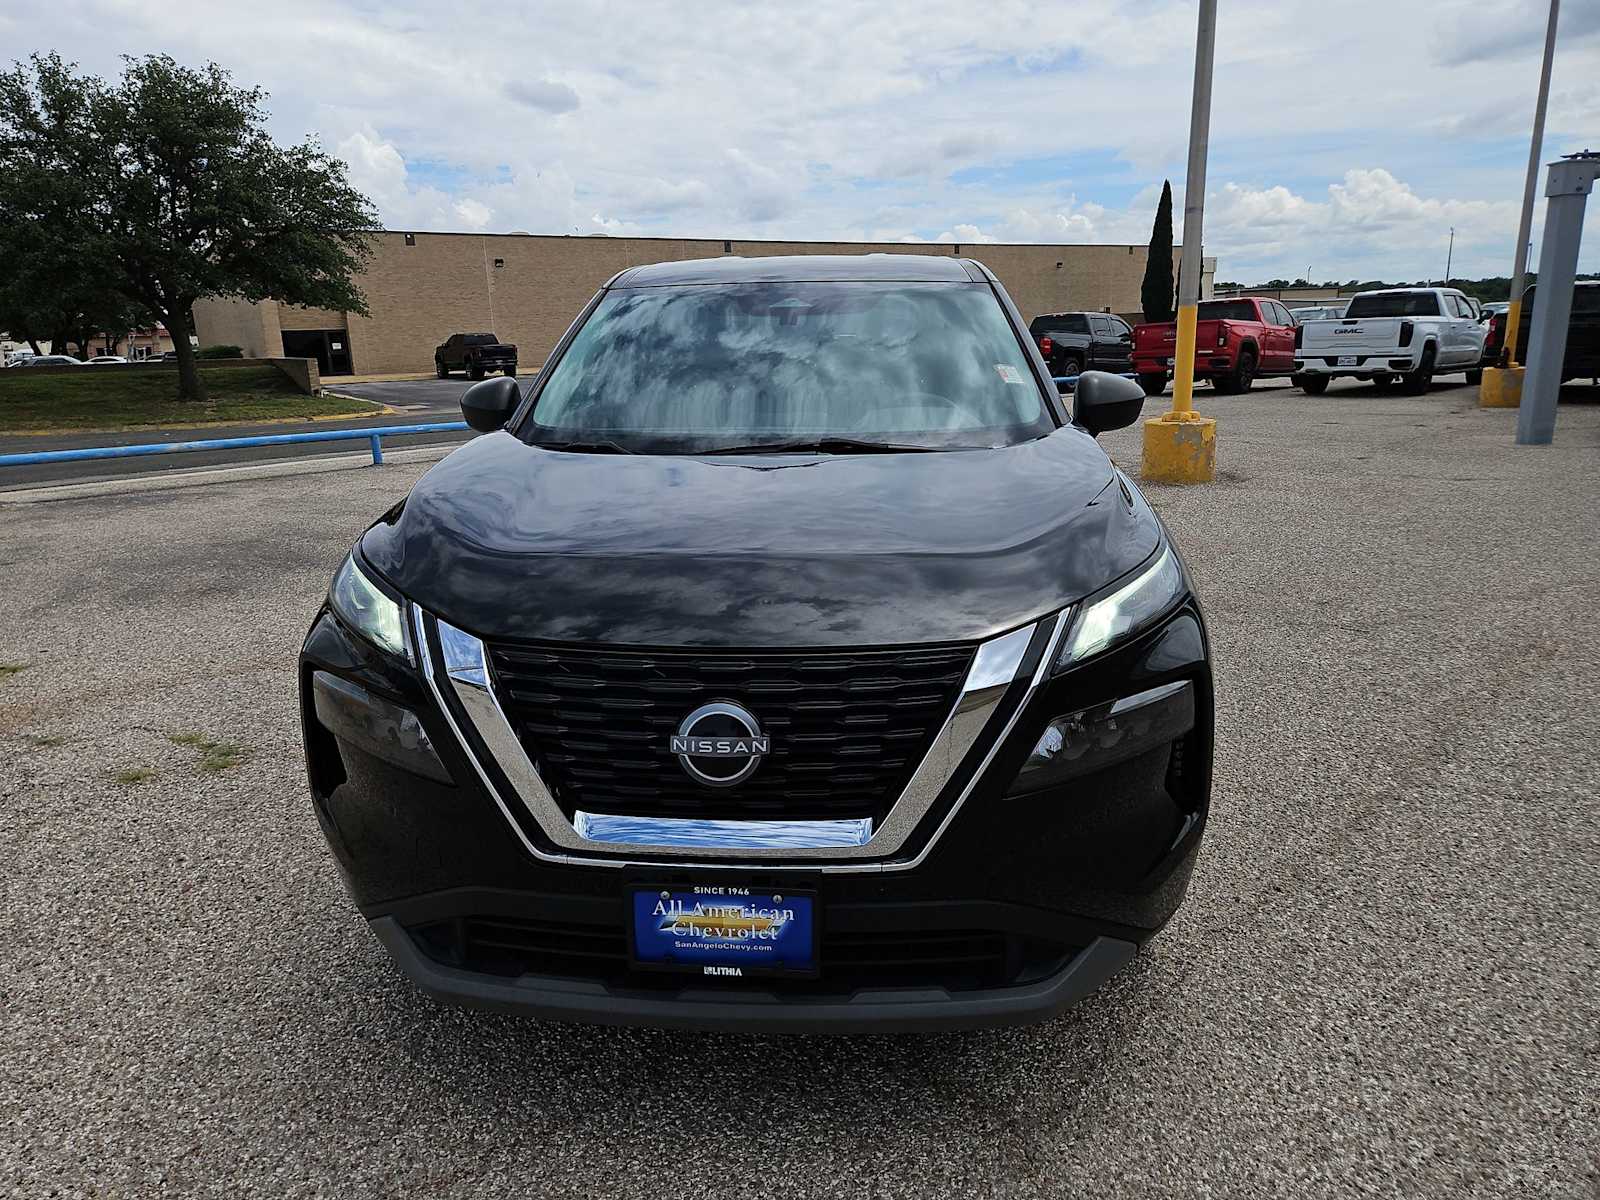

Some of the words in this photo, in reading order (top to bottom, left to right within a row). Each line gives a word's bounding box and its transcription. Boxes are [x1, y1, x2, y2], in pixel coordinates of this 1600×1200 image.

[673, 739, 767, 753] NISSAN
[694, 886, 724, 895] SINCE
[728, 887, 750, 896] 1946
[652, 900, 682, 916] All
[692, 901, 794, 921] American
[671, 921, 778, 940] Chevrolet
[674, 940, 772, 951] SanAngeloChevy.com
[712, 966, 743, 976] LITHIA
